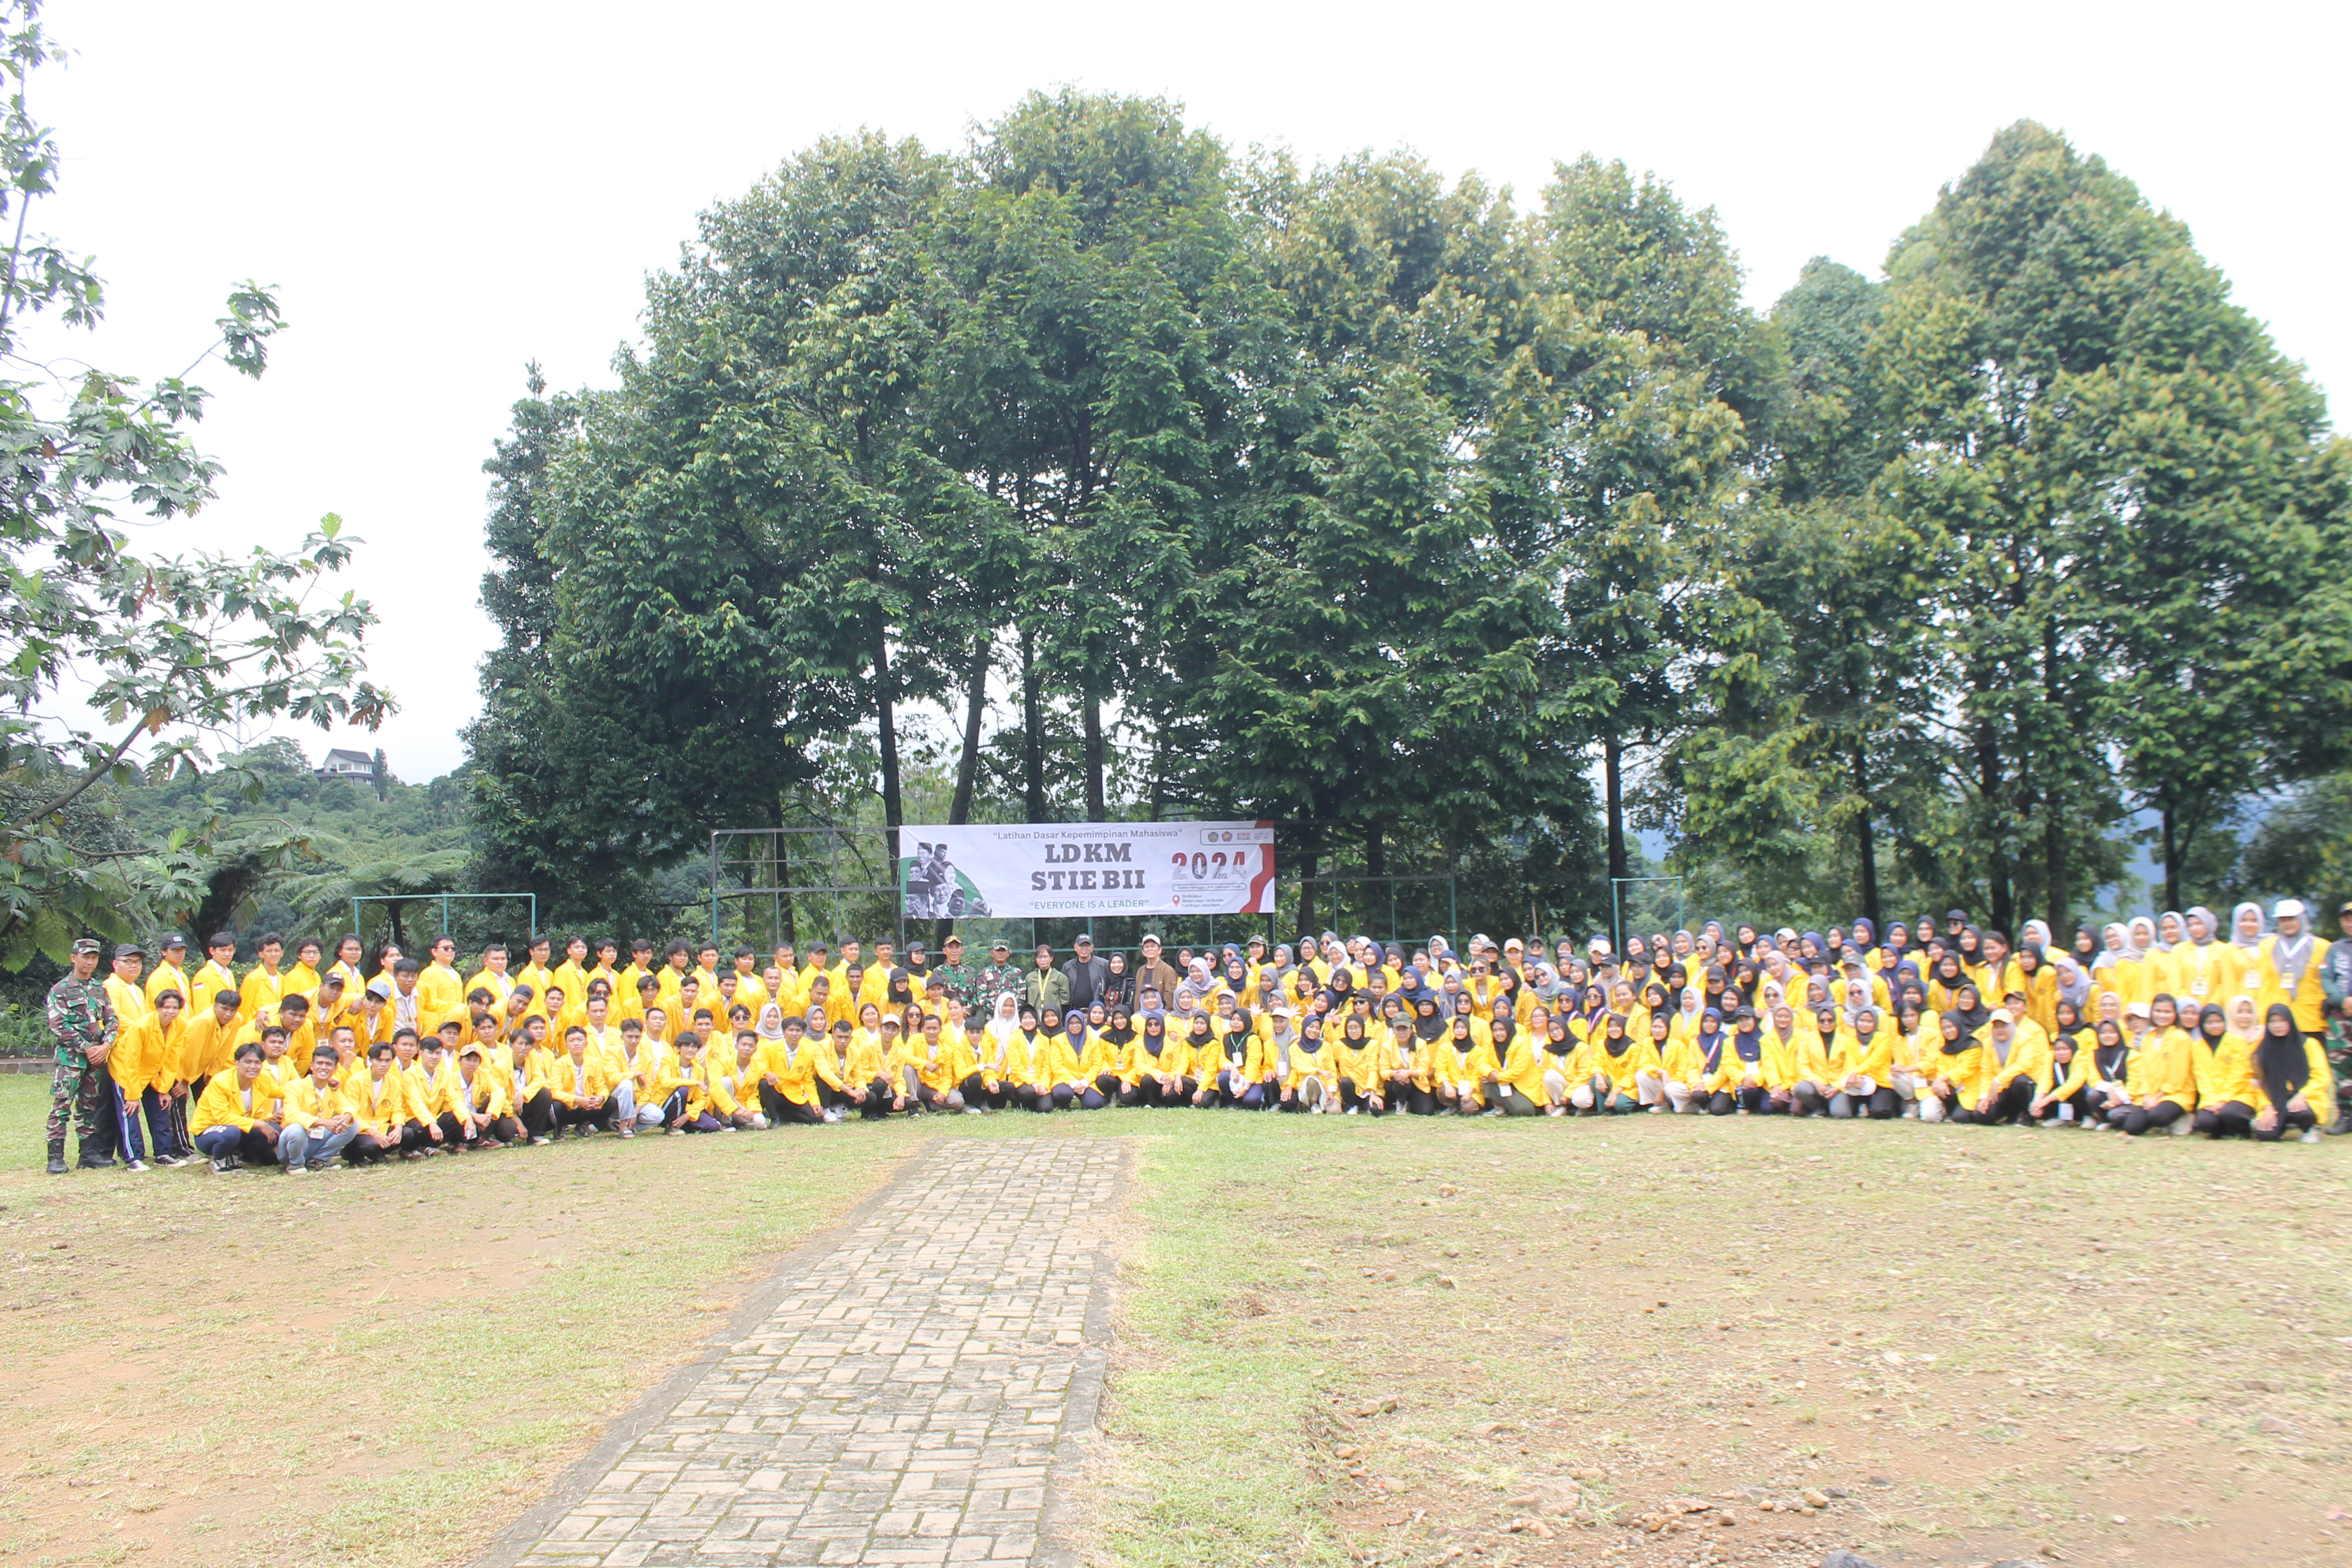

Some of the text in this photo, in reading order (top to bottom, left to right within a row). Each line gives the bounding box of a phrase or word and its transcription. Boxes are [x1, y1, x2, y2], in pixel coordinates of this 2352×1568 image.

[993, 831, 1031, 840] “Latihan
[1061, 830, 1128, 840] Kepemimpinan
[1130, 829, 1183, 838] Mahasiswa”
[1044, 843, 1132, 863] LDKM
[1172, 851, 1247, 880] 2024
[1031, 870, 1145, 891] STIE BII
[1030, 901, 1085, 910] “EVERYONE
[1108, 900, 1149, 908] LEADER”
